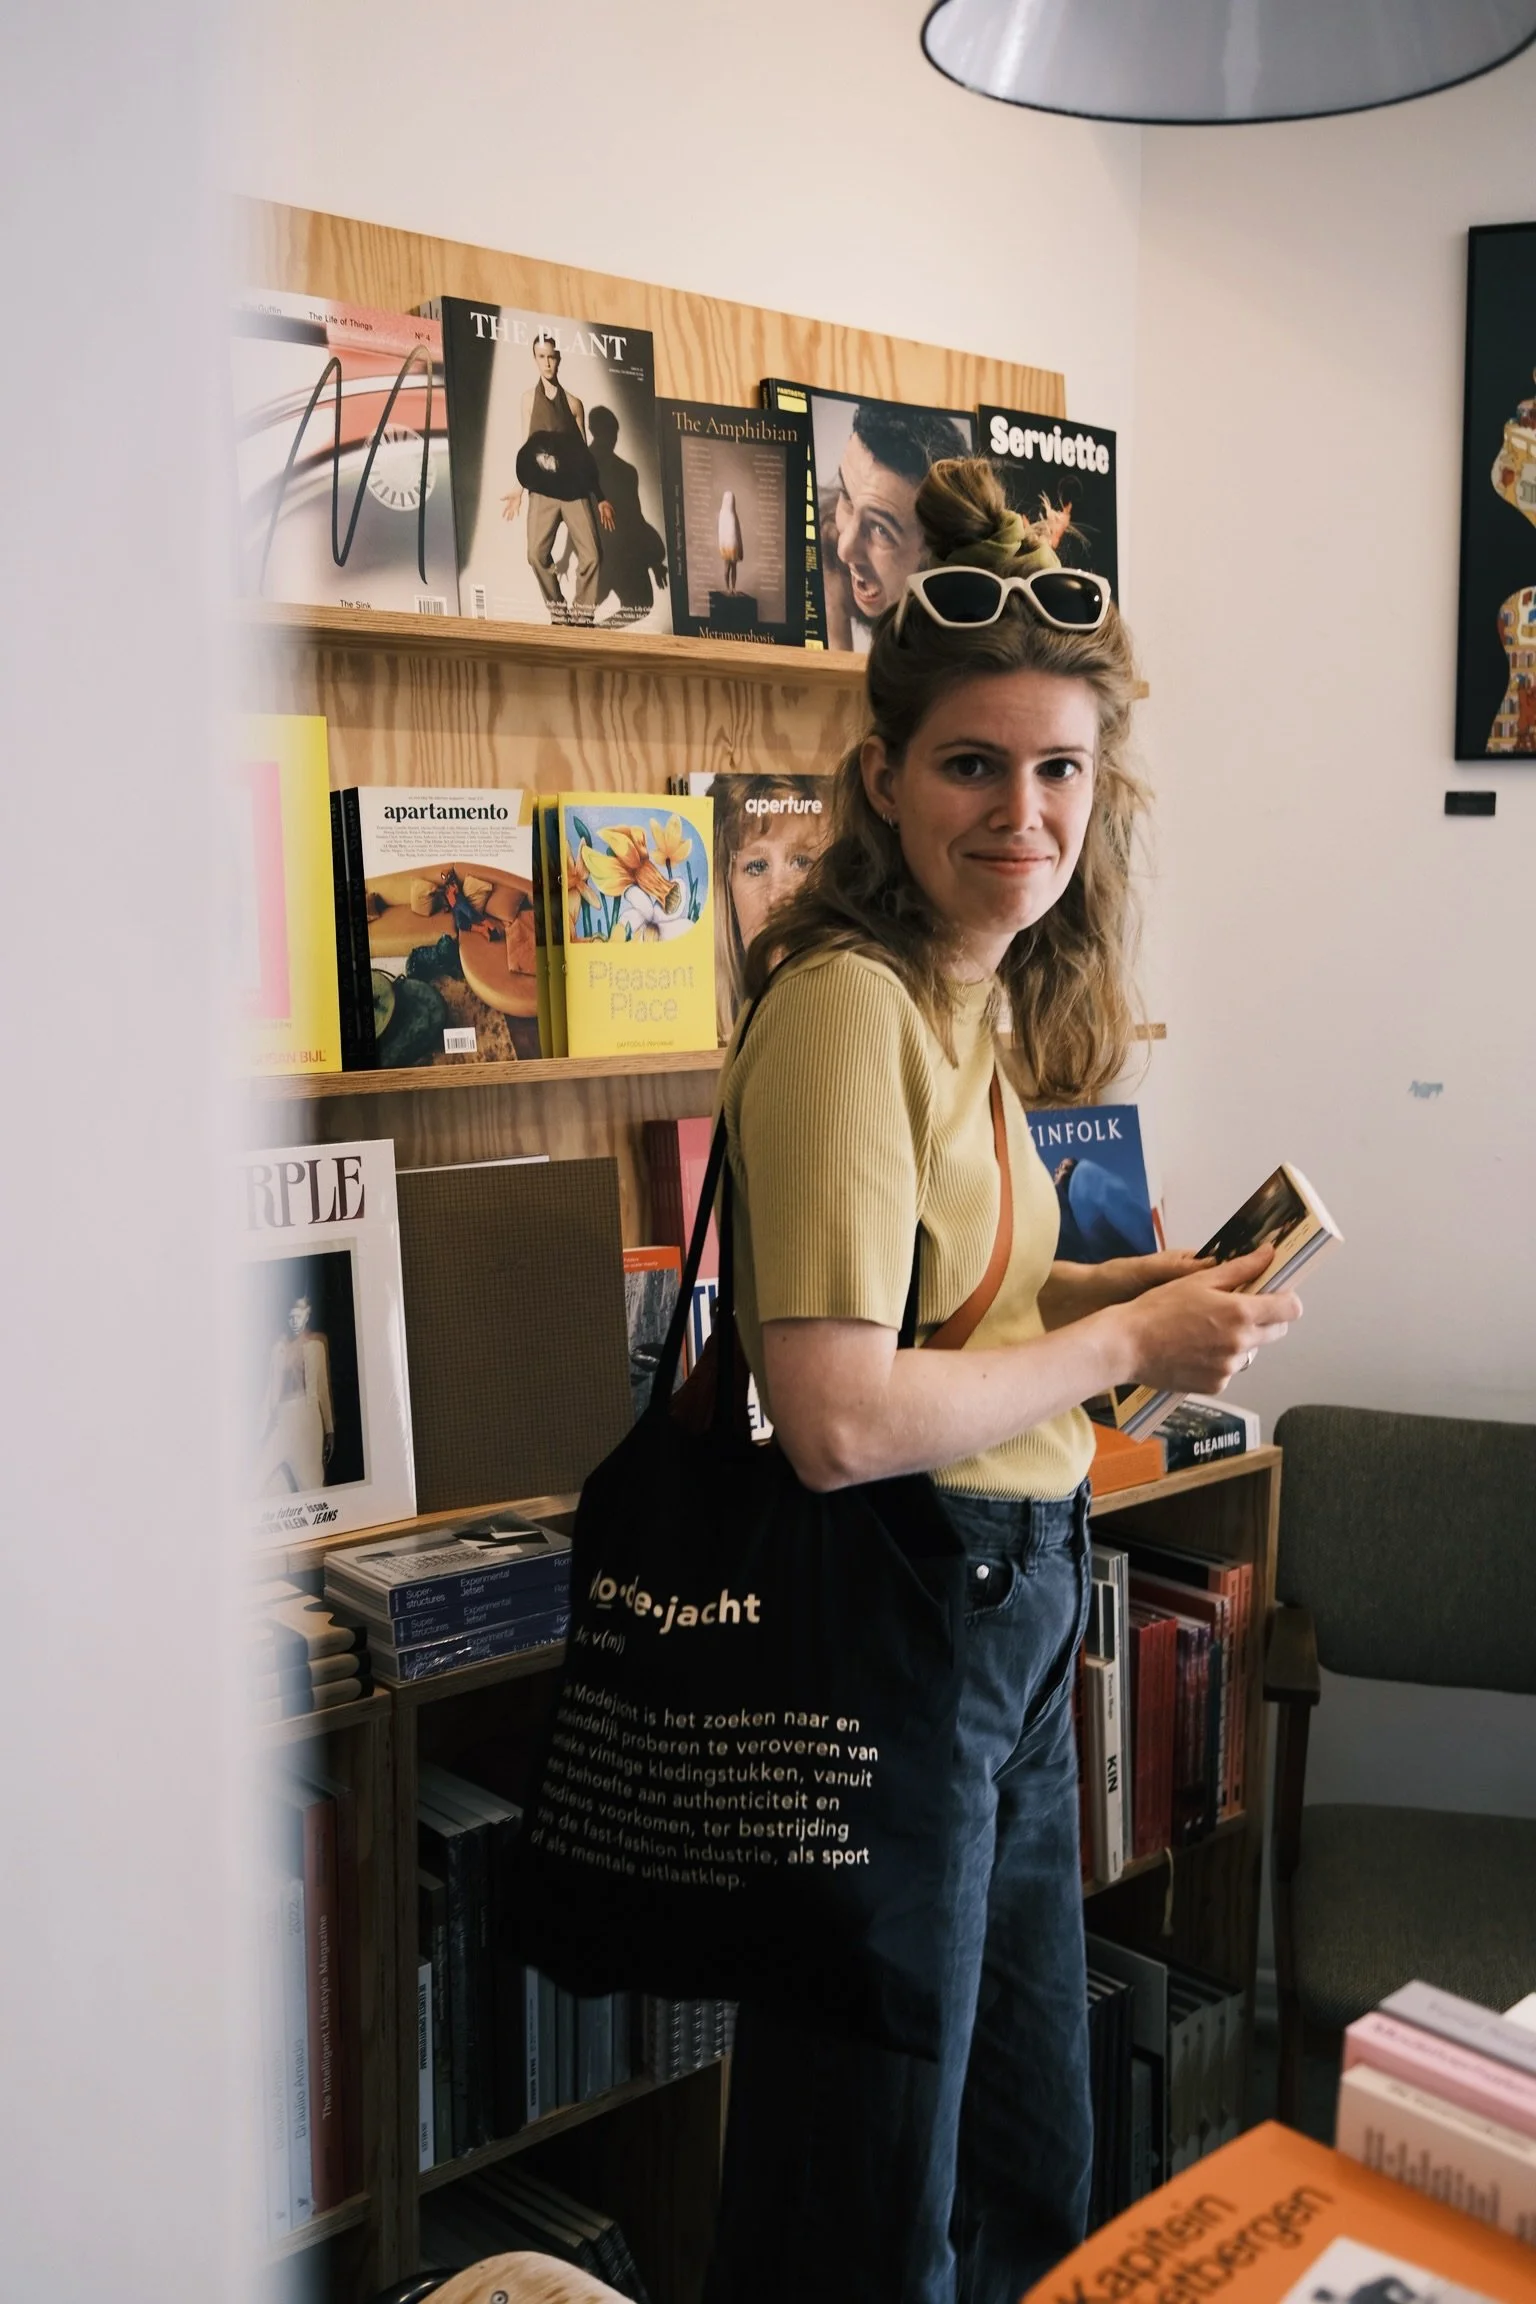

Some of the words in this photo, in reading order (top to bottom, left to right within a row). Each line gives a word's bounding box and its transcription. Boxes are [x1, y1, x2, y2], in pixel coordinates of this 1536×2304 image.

[308, 311, 324, 322] The
[325, 314, 338, 325] Life
[340, 317, 349, 326] of
[350, 318, 374, 332] Things
[470, 311, 535, 346] THE
[537, 324, 628, 361] PLANT
[672, 410, 702, 432] The
[705, 416, 798, 445] Amphibian
[989, 414, 1110, 475] Serviette
[340, 599, 356, 608] The
[357, 601, 372, 611] Sink
[698, 626, 775, 644] Metamorphosis
[383, 802, 509, 824] apartamento
[745, 796, 823, 815] aperture
[588, 960, 695, 992] Pleasant
[610, 992, 679, 1024] Place
[1193, 1430, 1241, 1457] CLEANING
[305, 1501, 329, 1514] issue
[312, 1508, 339, 1526] JEANS
[460, 1570, 510, 1588] Experimental
[460, 1585, 485, 1598] Jetset
[406, 1587, 433, 1600] Super-
[406, 1593, 446, 1609] structures
[463, 1599, 513, 1617] Experimental
[464, 1613, 487, 1625] Jetset
[411, 1623, 449, 1639] structures
[466, 1628, 515, 1647] Experimental
[644, 1704, 656, 1725] is
[664, 1707, 696, 1729] het
[703, 1710, 776, 1731] zoeken
[784, 1710, 829, 1731] naar
[837, 1716, 860, 1734] en
[622, 1731, 700, 1756] proberen
[708, 1738, 729, 1757] te
[736, 1738, 840, 1759] veroveren
[847, 1743, 879, 1761] van
[588, 1742, 643, 1777] vintage
[648, 1757, 804, 1788] kledingstukken,
[814, 1766, 872, 1788] vanuit
[1105, 1754, 1118, 1793] KIN
[567, 1759, 632, 1799] behoefte
[638, 1787, 667, 1807] aan
[672, 1789, 807, 1813] authenticiteit
[816, 1794, 840, 1811] en
[598, 1801, 695, 1842] voorkomen,
[703, 1819, 730, 1838] ter
[738, 1819, 849, 1843] bestrijding
[558, 1811, 579, 1835] de
[683, 1843, 778, 1867] industrie,
[787, 1847, 815, 1866] als
[822, 1845, 870, 1870] sport
[546, 1836, 568, 1856] als
[571, 1844, 636, 1877] mentale
[641, 1857, 747, 1891] uitlaatklep.
[317, 1914, 331, 1975] Magazine
[318, 1976, 332, 2030] Lifestyle
[320, 2031, 334, 2094] Intelligent
[321, 2095, 333, 2121] The
[1046, 2194, 1238, 2304] Kapitein
